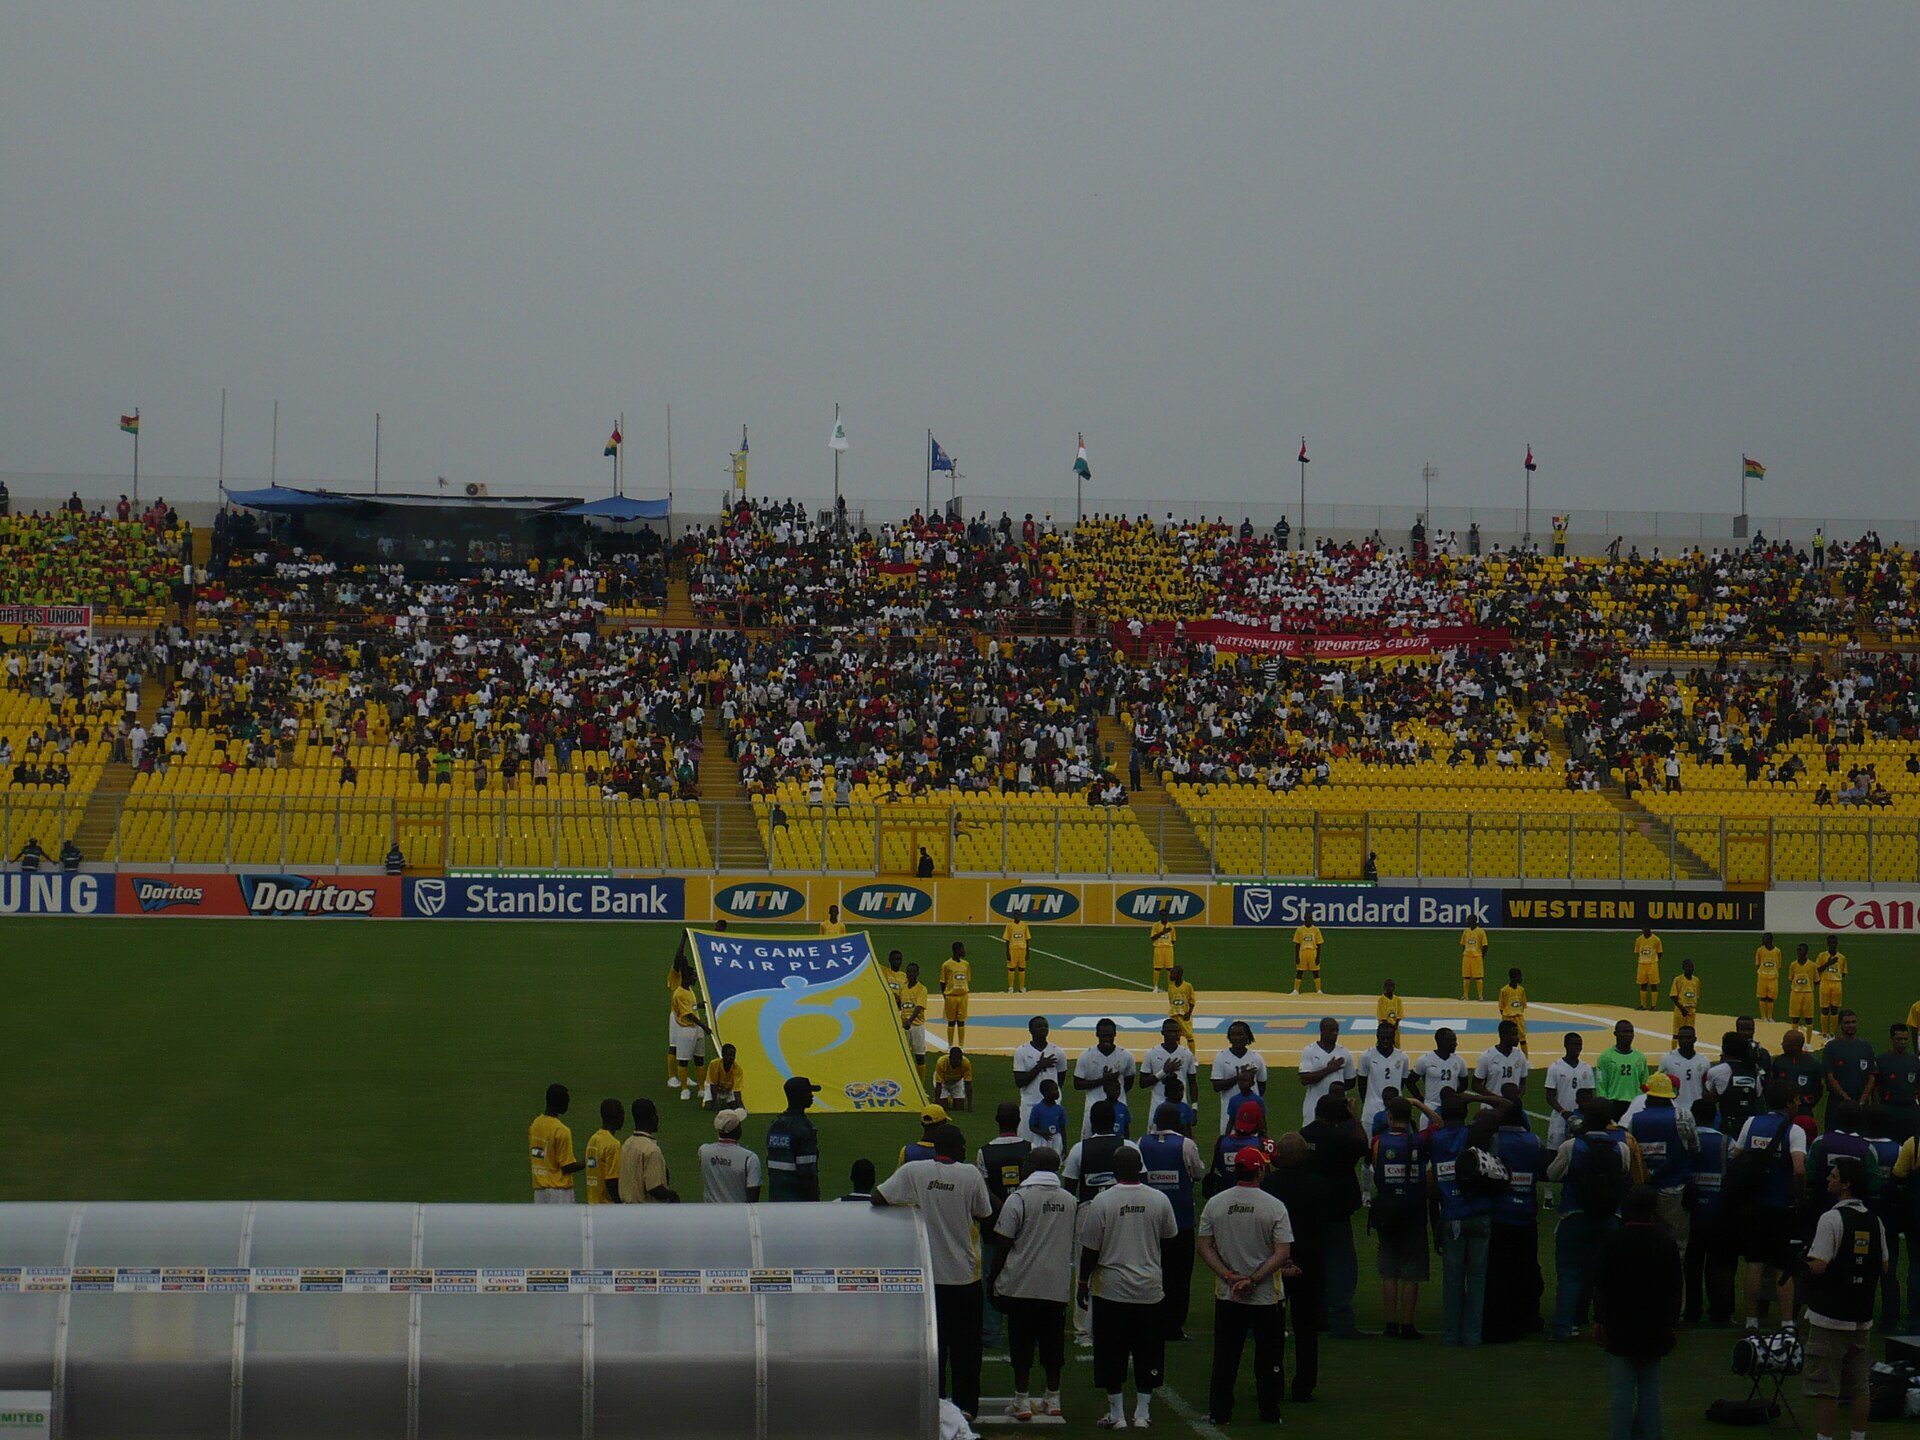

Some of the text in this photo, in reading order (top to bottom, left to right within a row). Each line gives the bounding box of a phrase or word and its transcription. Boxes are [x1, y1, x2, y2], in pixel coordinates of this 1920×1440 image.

[47, 609, 84, 624] UNION
[1216, 635, 1296, 651] NATIONWIDE
[1386, 636, 1430, 649] GROUP
[0, 875, 97, 912] UNG
[139, 882, 203, 900] Doritos
[251, 880, 376, 912] Doritos
[466, 884, 668, 914] Stanbic Bank
[731, 890, 789, 911] MTN
[858, 891, 918, 912] MTN
[1006, 893, 1066, 913] MTN
[1132, 895, 1192, 914] MTN
[1281, 895, 1490, 924] Standard Bank
[1508, 899, 1735, 920] WESTERN UNION
[1815, 894, 1920, 929] Can
[710, 941, 854, 957] MY GAME IS
[714, 955, 855, 971] FAIR PLAY
[1621, 1064, 1632, 1076] 22
[854, 1098, 907, 1109] FIFA
[769, 1135, 792, 1147] POLICE
[927, 1179, 955, 1191] ghana
[1149, 1173, 1177, 1181] Canon
[1120, 1204, 1146, 1216] ghana
[1228, 1204, 1255, 1215] ghana
[881, 1284, 923, 1292] SAMSUNG
